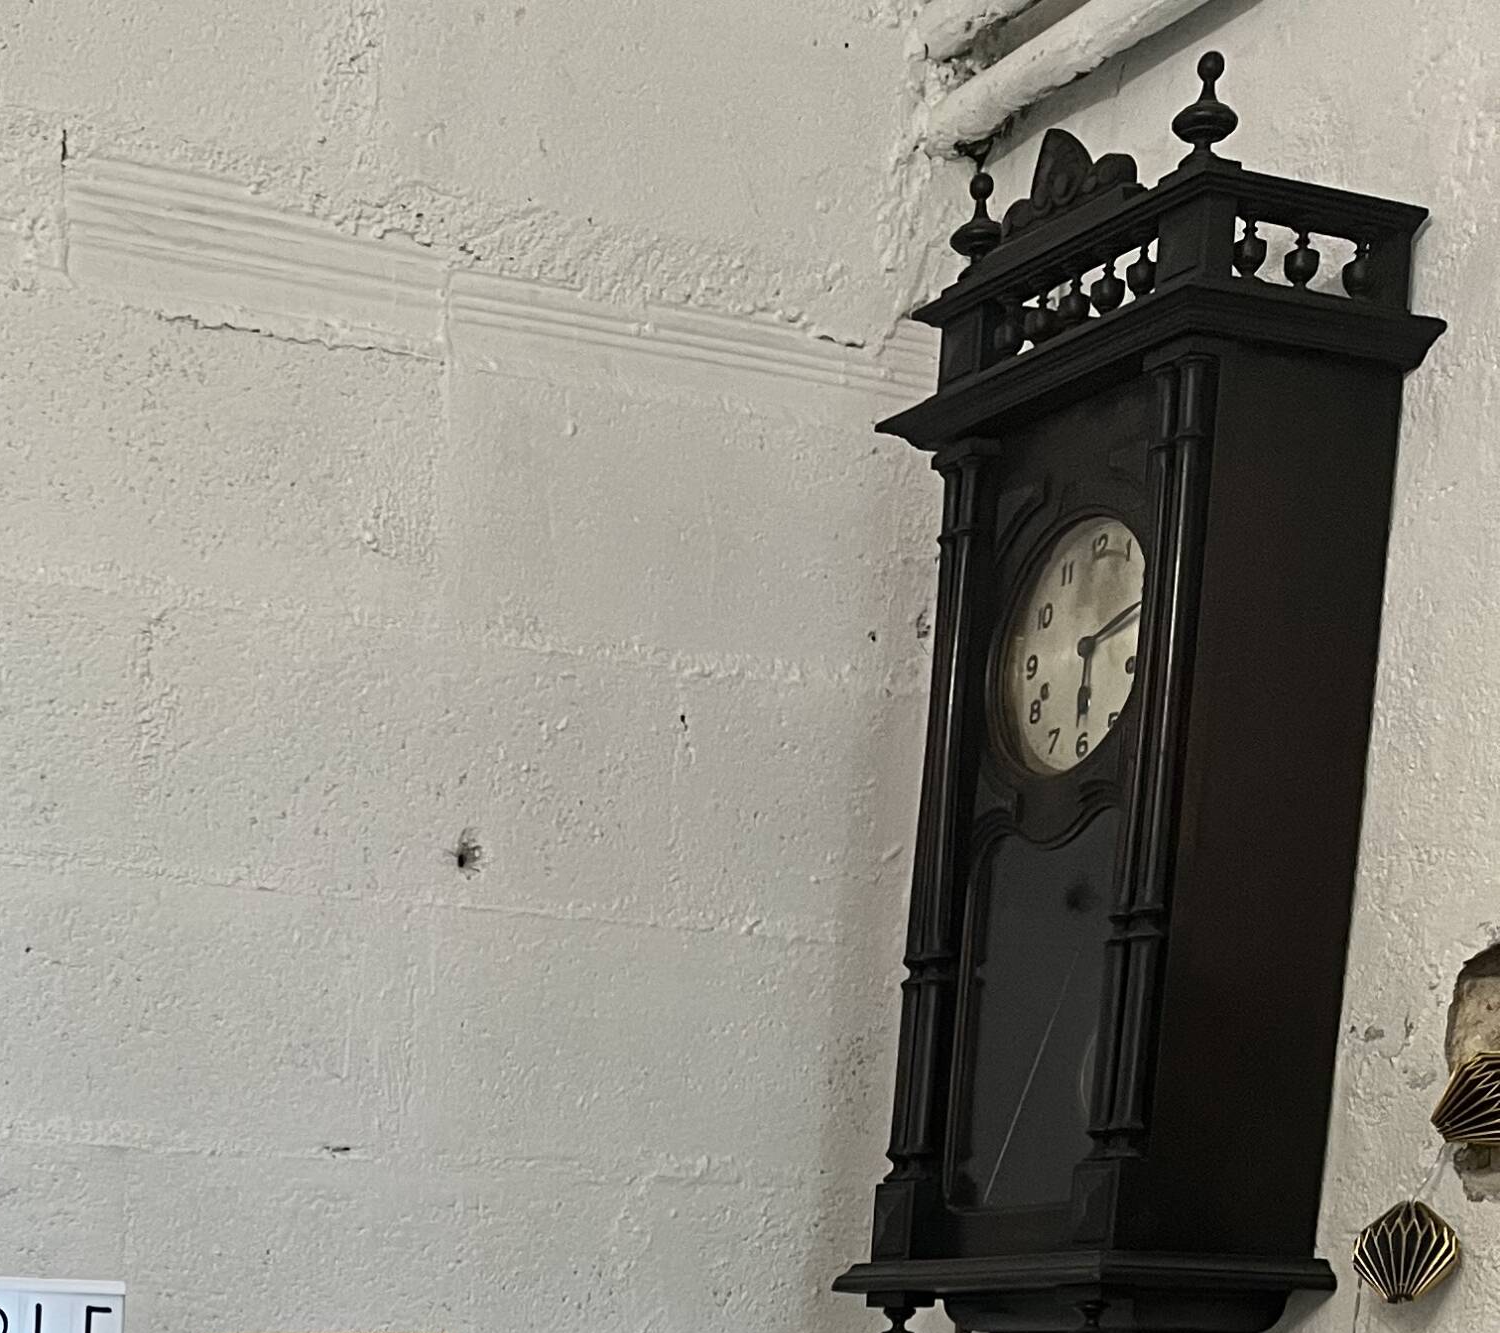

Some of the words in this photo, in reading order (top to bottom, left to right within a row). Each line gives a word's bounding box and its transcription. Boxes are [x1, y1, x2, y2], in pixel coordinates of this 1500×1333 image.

[1091, 533, 1109, 560] 12
[1125, 538, 1132, 562] 1
[1060, 561, 1075, 587] 11
[1037, 602, 1053, 631] 10
[1026, 654, 1039, 680] 9
[1029, 700, 1041, 724] 8
[1047, 727, 1061, 755] 7
[1075, 732, 1088, 758] 6
